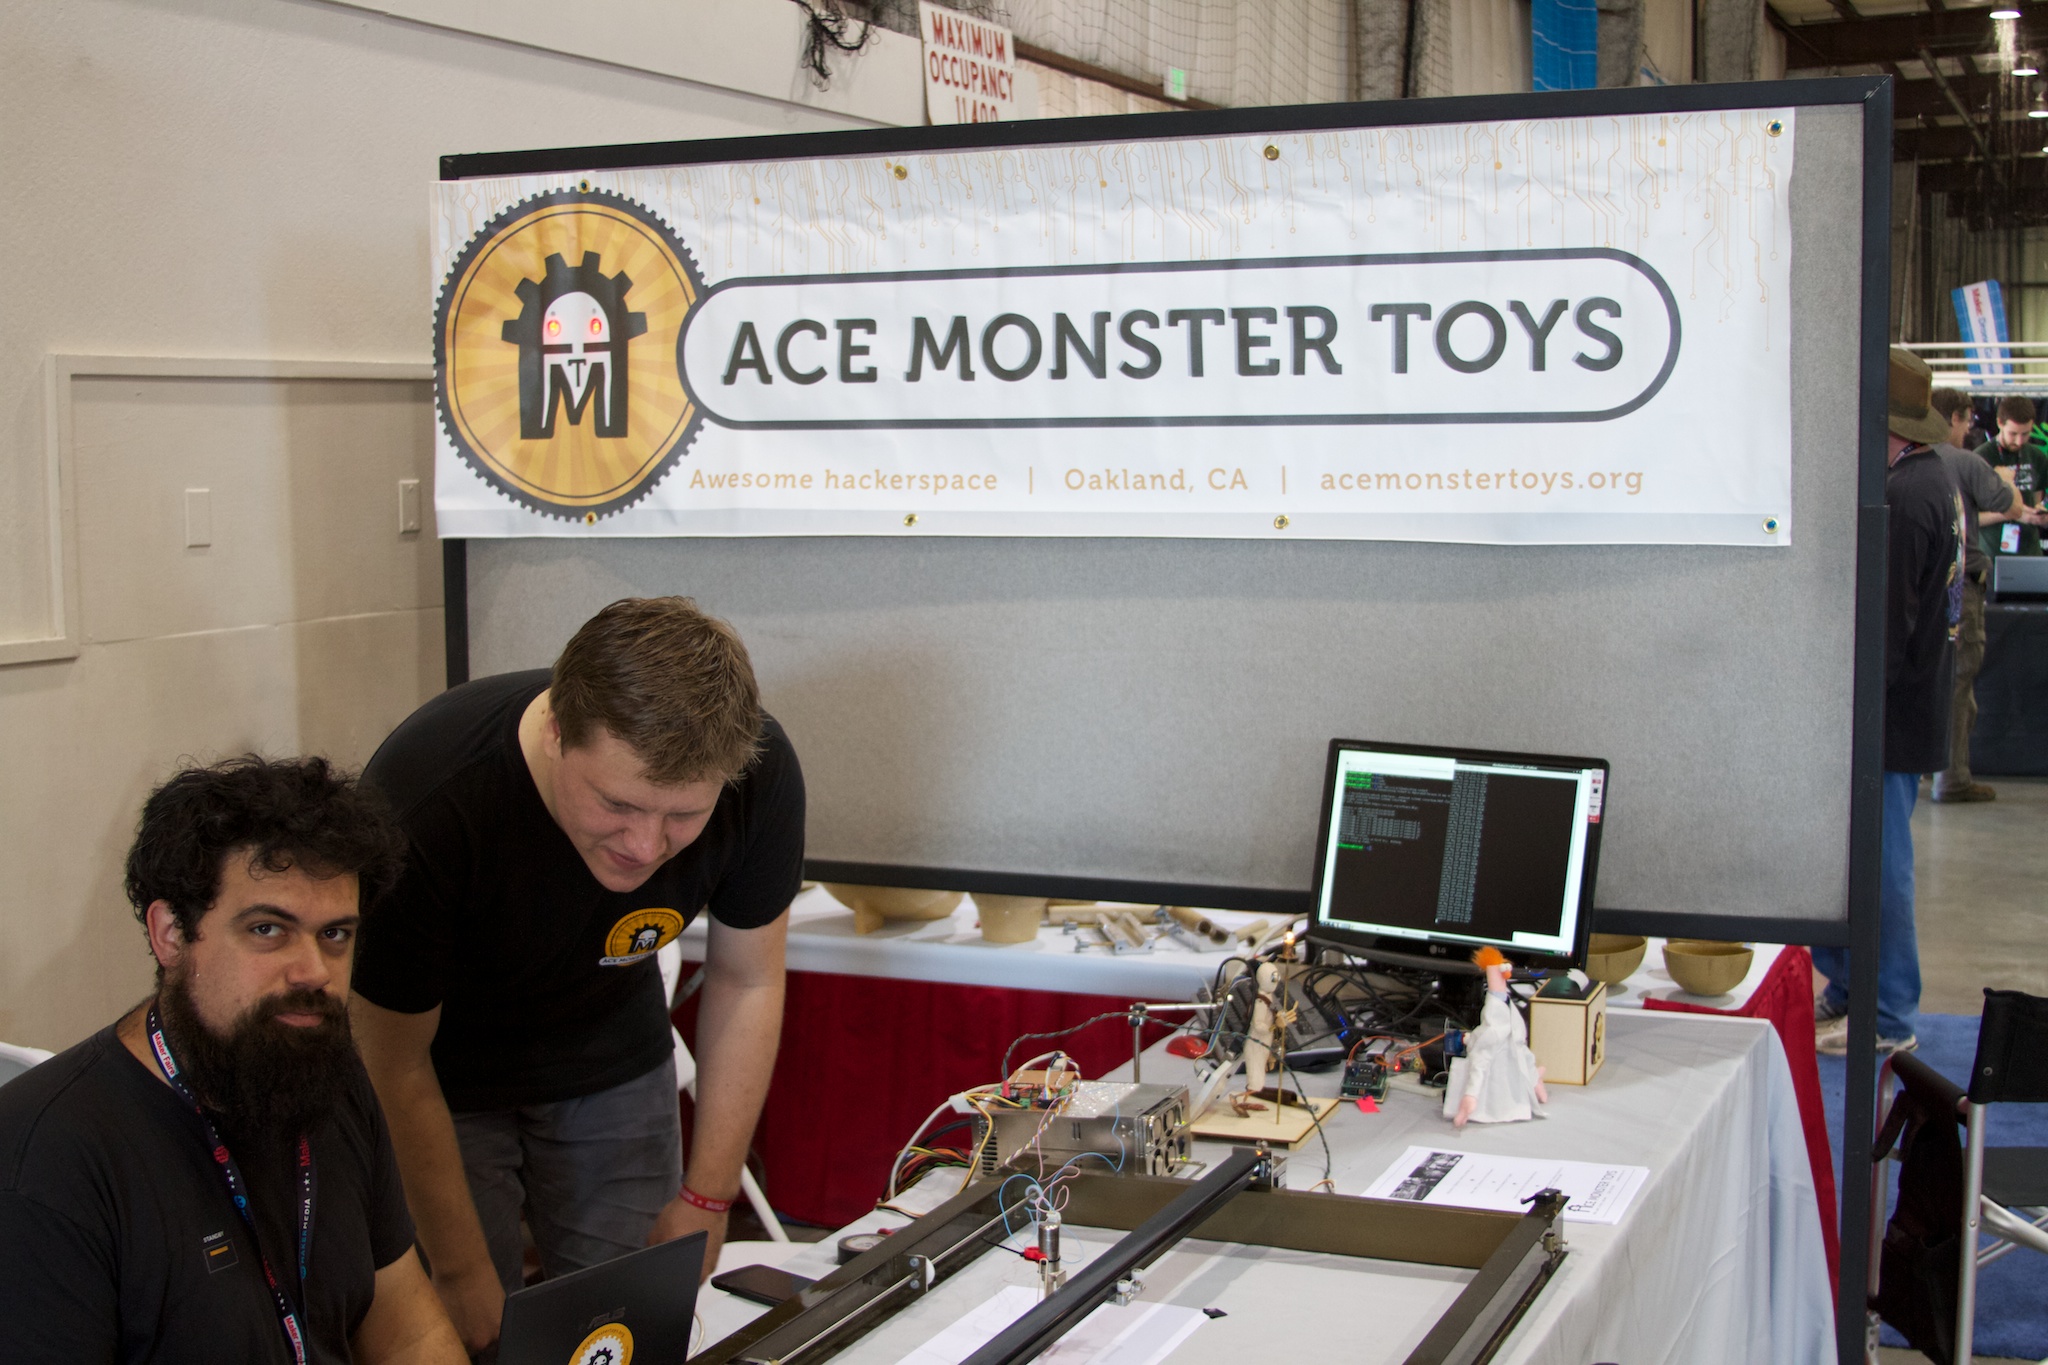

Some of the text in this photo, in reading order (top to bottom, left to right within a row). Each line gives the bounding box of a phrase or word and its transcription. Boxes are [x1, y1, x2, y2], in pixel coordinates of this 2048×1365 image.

[931, 11, 1006, 64] MAXIMUM
[929, 50, 1014, 103] OCCUPANCY
[722, 296, 1623, 386] ACE MONSTER TOYS
[689, 467, 1644, 495] Awesome hackerspace Oakland, CA acemonstertoys.org
[153, 1033, 176, 1076] Maker Faire
[303, 1198, 312, 1230] MEDIA
[285, 1317, 300, 1340] Maker
